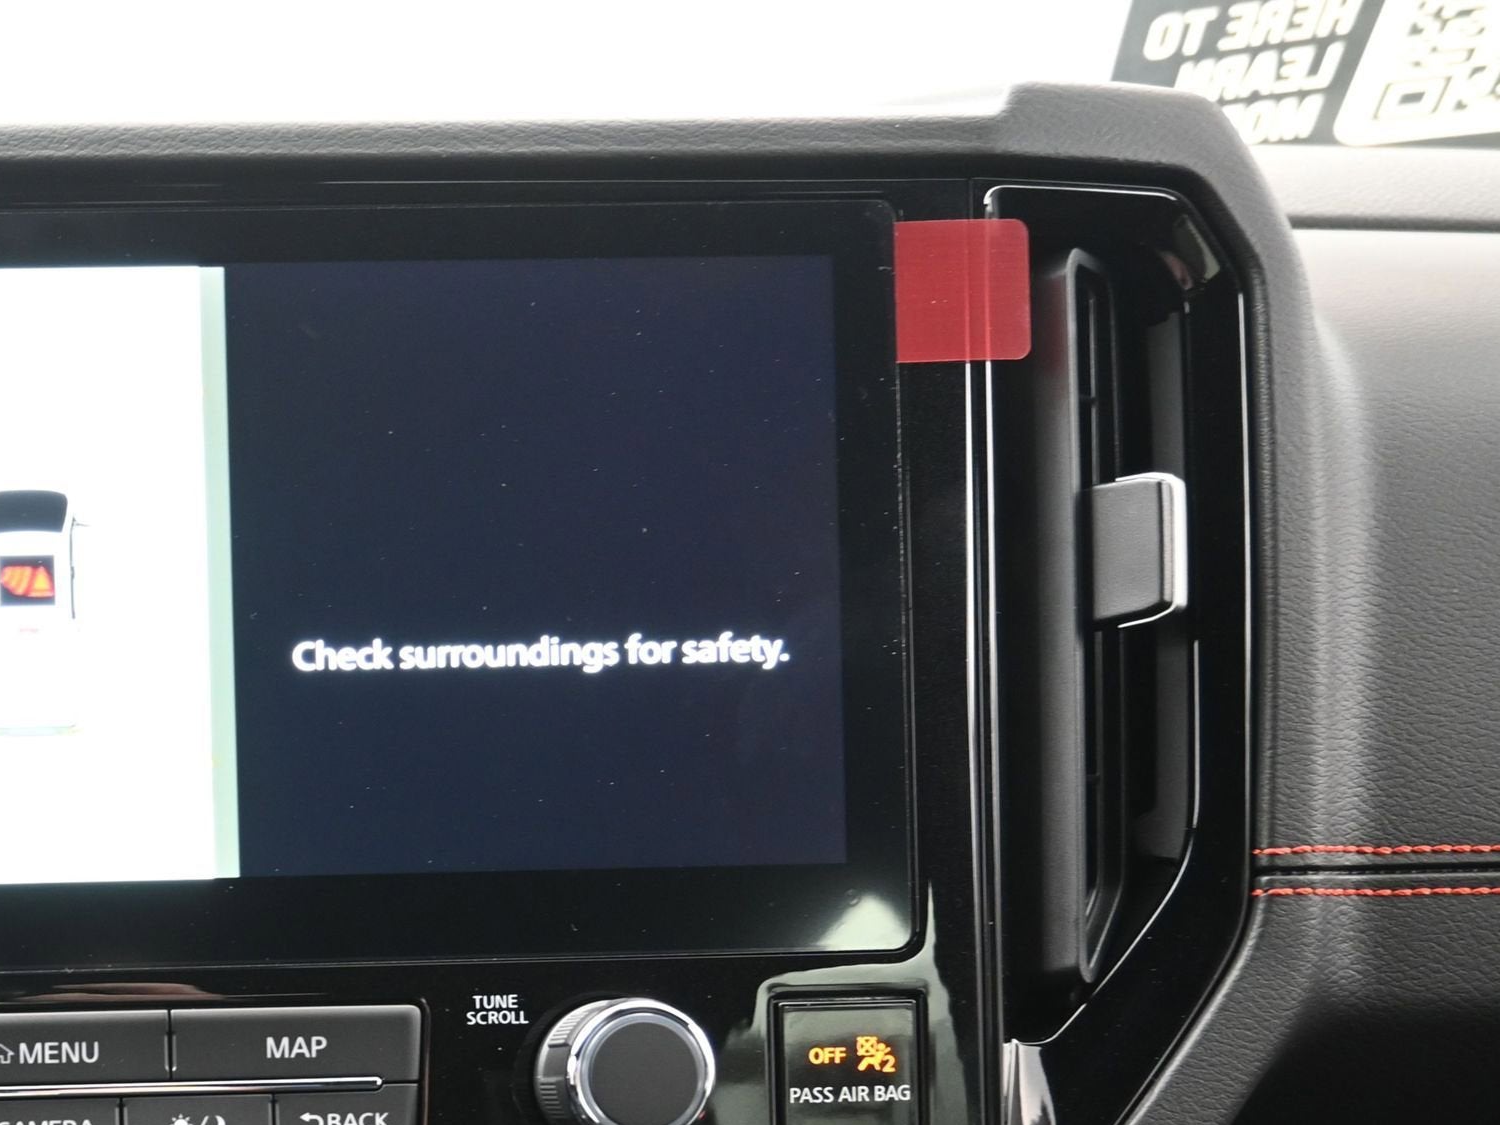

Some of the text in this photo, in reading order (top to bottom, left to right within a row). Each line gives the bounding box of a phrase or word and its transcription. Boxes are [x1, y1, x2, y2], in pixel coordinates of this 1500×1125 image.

[291, 630, 791, 674] Check surroundings for safety.
[472, 993, 519, 1010] TUNE
[466, 1006, 530, 1026] SCROLL
[19, 1041, 99, 1065] MENU
[266, 1035, 328, 1059] MAP
[808, 1046, 847, 1065] OFF
[789, 1084, 911, 1104] PASS AIR BAG
